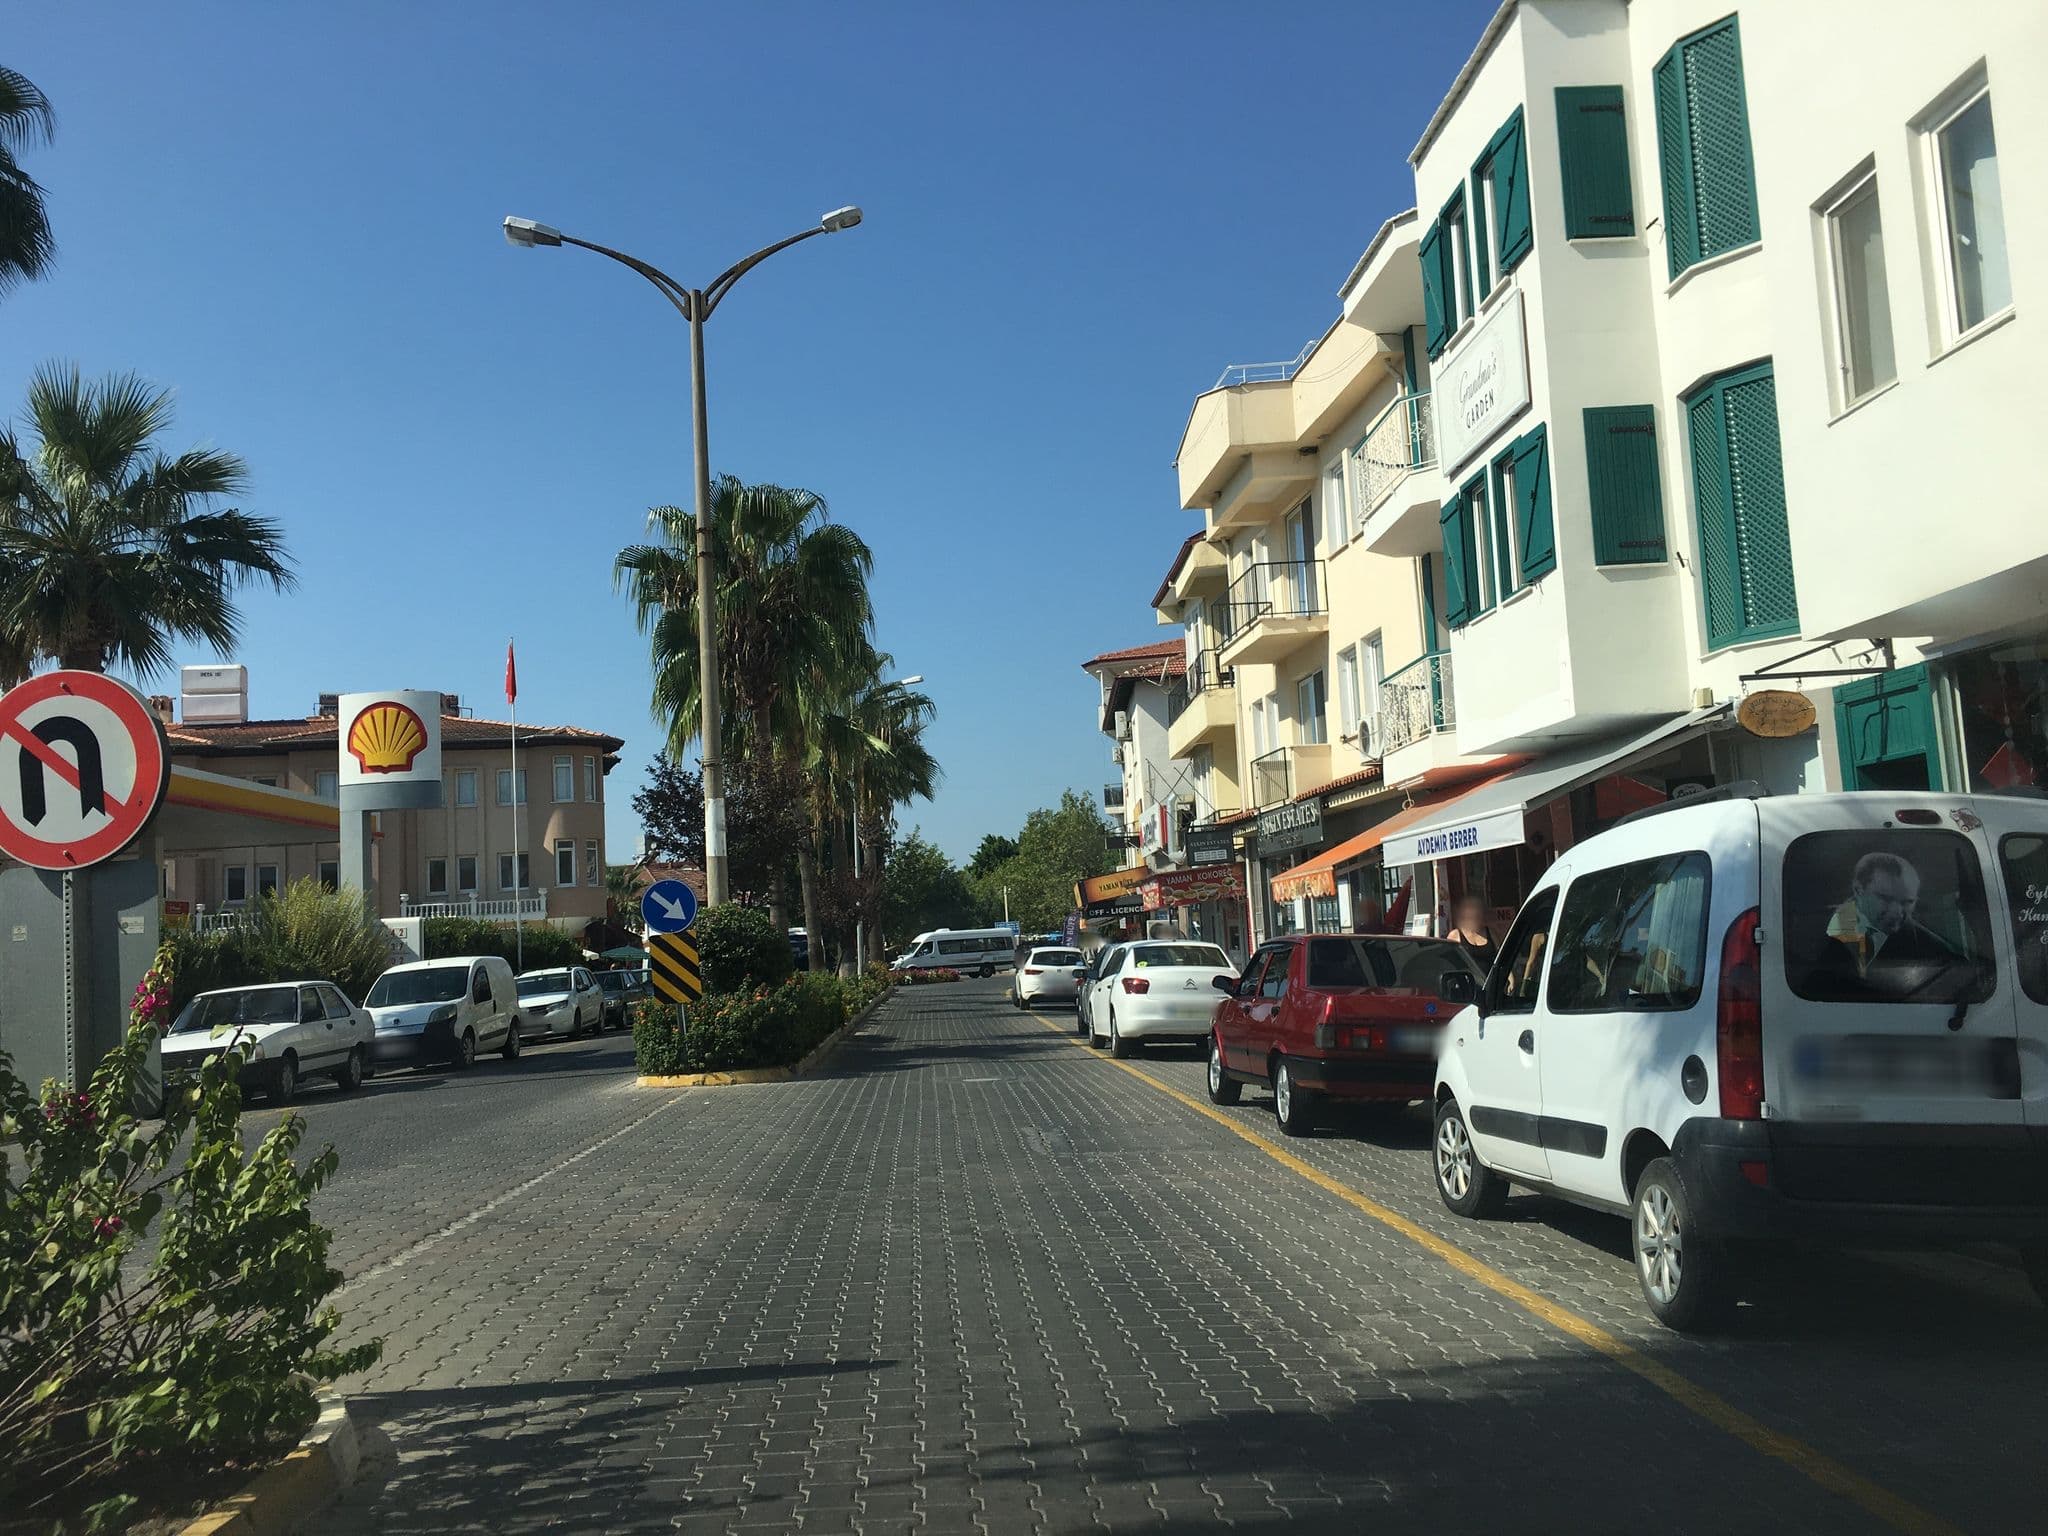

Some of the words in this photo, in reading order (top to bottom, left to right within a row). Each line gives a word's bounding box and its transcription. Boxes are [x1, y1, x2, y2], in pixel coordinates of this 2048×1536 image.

[1459, 351, 1497, 419] Grandma's
[1465, 388, 1495, 429] GARDEN
[1282, 802, 1317, 830] ESTATES
[1449, 827, 1479, 849] BERBER
[1098, 881, 1120, 893] YAMAN
[1165, 874, 1193, 885] YAMAN
[1089, 909, 1105, 917] OFF
[1110, 905, 1145, 915] LICENCE
